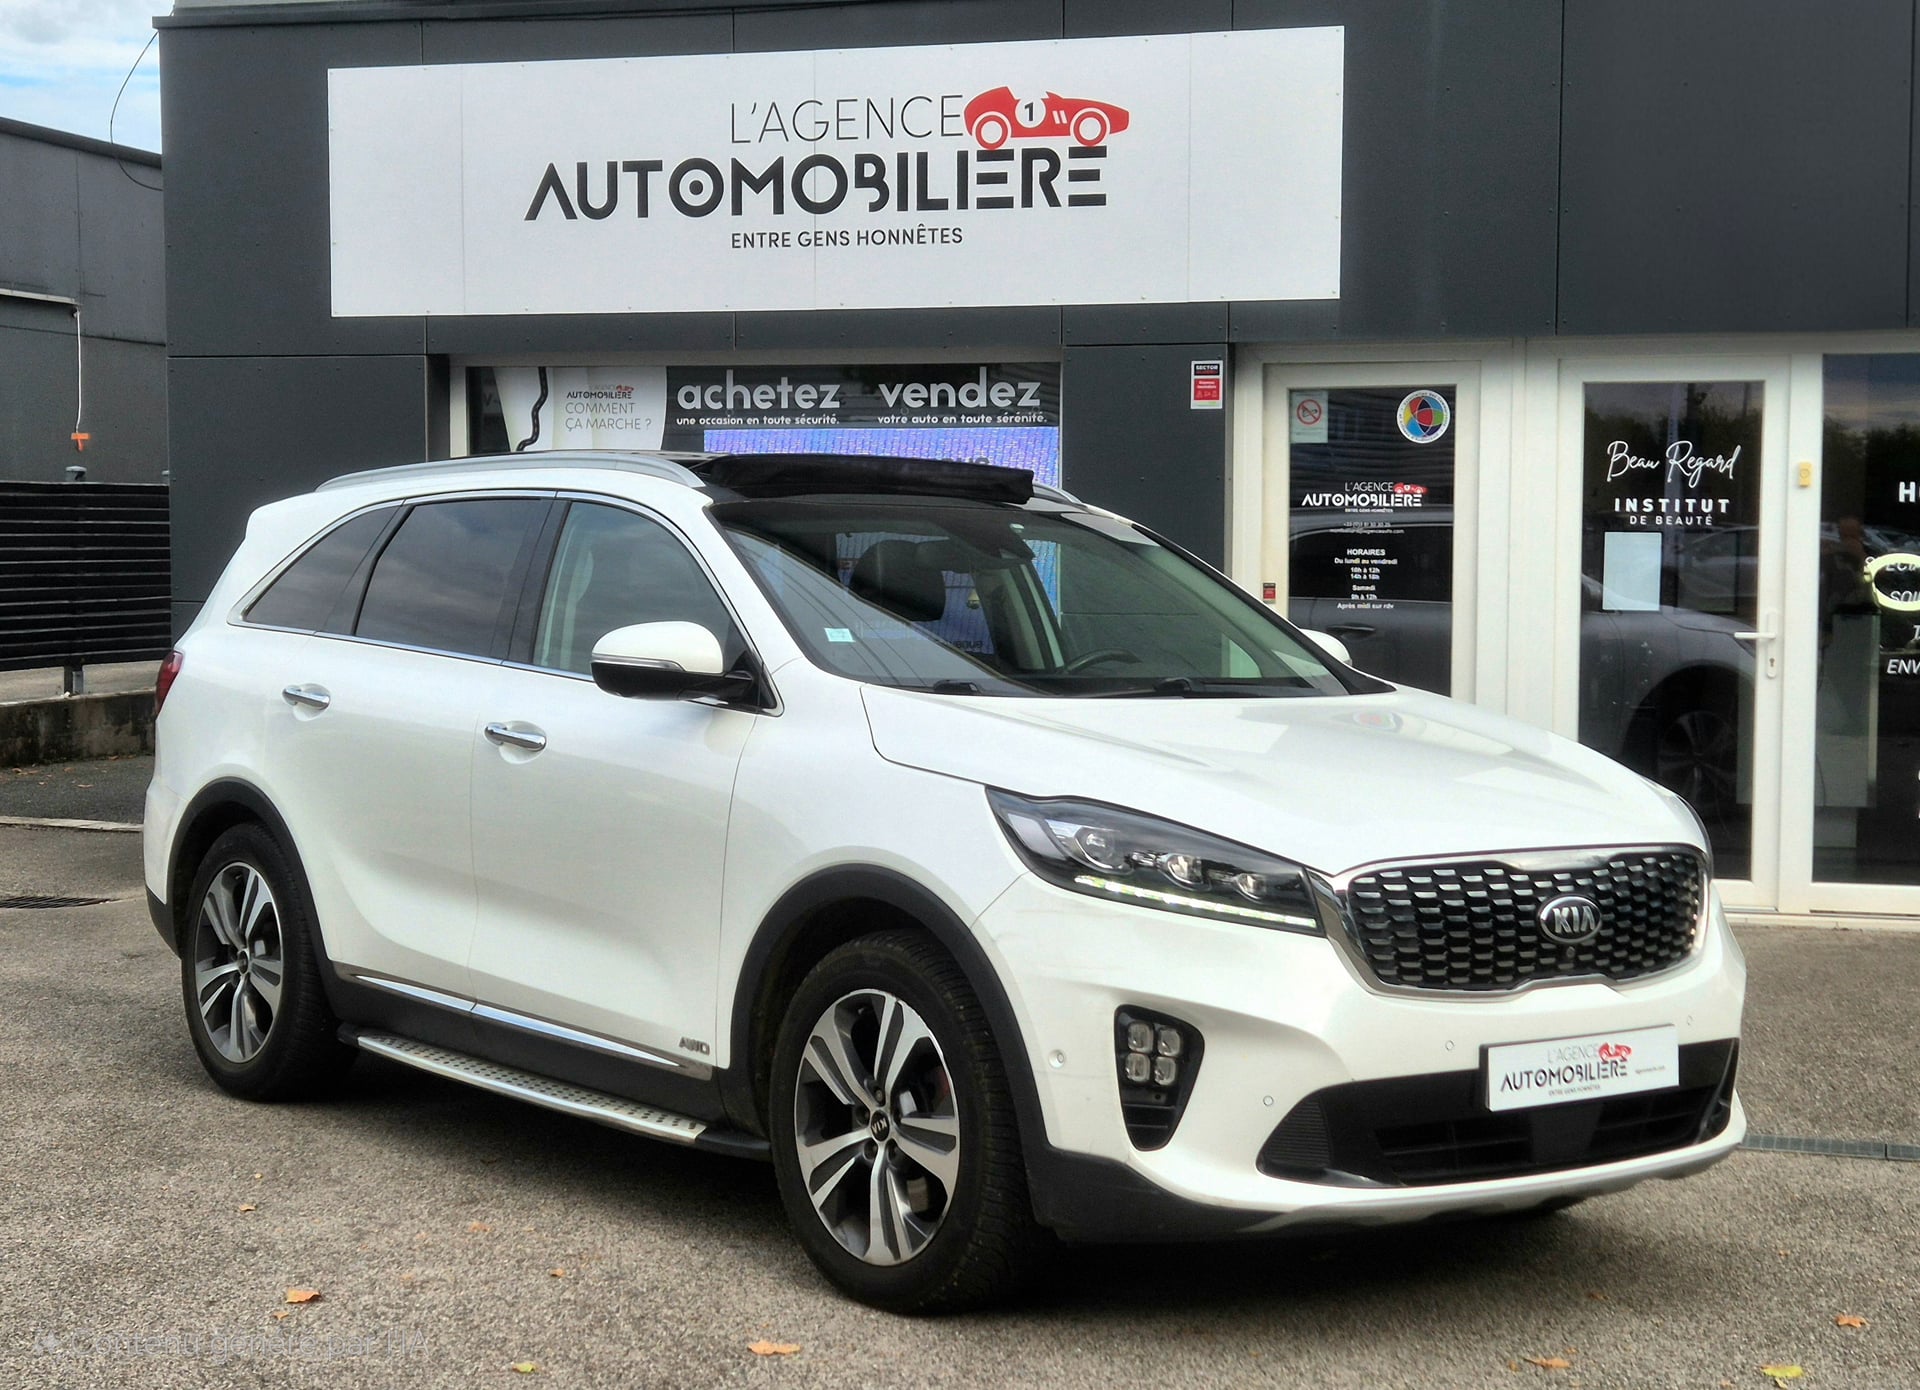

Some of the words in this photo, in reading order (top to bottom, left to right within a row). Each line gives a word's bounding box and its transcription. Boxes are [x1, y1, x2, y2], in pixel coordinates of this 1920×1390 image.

[731, 94, 963, 143] L'AGENCE
[1024, 102, 1034, 121] 1
[731, 231, 791, 248] ENTRE
[798, 230, 850, 247] GENS
[857, 224, 963, 245] HONNÊTES
[677, 369, 840, 410] achetez
[879, 367, 1041, 408] vendez
[565, 402, 635, 414] COMMENT
[565, 418, 583, 431] ÇA
[586, 418, 641, 430] MARCHE
[645, 418, 652, 430] ?
[699, 415, 743, 425] occasion
[763, 415, 791, 425] toute
[795, 413, 839, 425] sécurité.
[878, 415, 907, 424] votre
[911, 415, 938, 424] auto
[942, 416, 957, 424] en
[961, 414, 992, 424] toute
[997, 412, 1047, 424] sérénité.
[1607, 440, 1660, 482] Beau
[1666, 440, 1741, 488] Regard
[1344, 482, 1393, 491] L'AGENCE
[1614, 498, 1730, 513] INSTITUT
[1629, 515, 1647, 525] DE
[1655, 514, 1713, 525] BEAUTÉ
[1552, 905, 1595, 933] KIA
